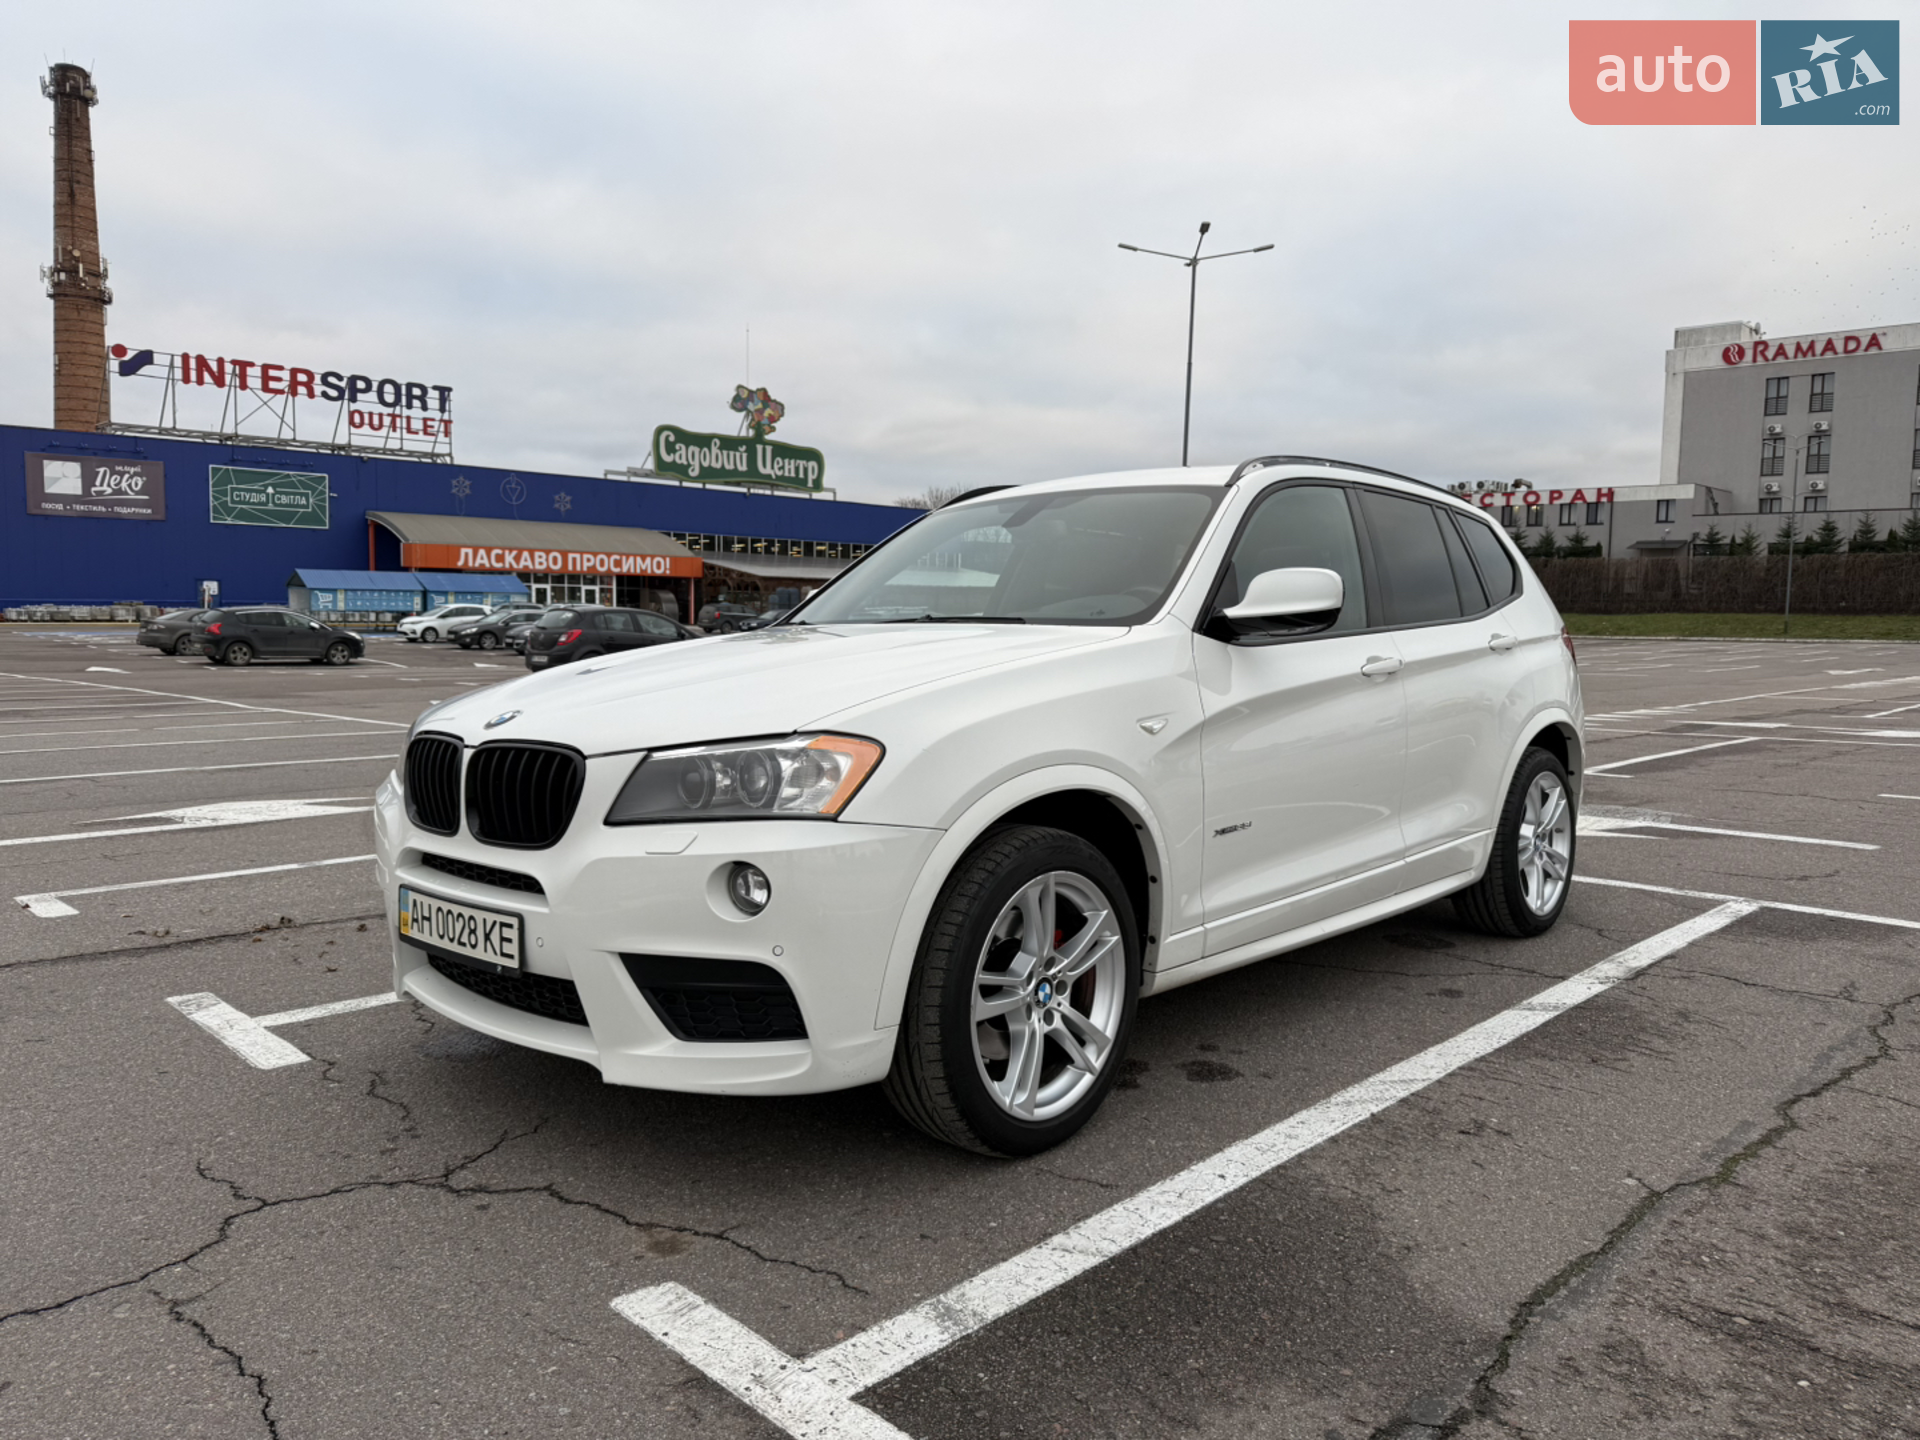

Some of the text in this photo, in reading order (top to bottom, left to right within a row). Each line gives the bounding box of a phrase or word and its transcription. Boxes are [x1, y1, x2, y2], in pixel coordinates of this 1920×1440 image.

[1752, 332, 1883, 363] RAMADA
[181, 351, 453, 414] INTERSPORT
[349, 409, 453, 439] OUTLET
[659, 430, 819, 488] Садовий Центр
[90, 466, 144, 497] Деко
[41, 502, 64, 511] ПОСУД
[72, 503, 107, 513] ТЕКСТИЛЬ
[232, 491, 307, 505] СТУДІЯ СВІТЛА
[456, 547, 671, 574] ЛАСКАВО ПРОСИМО!
